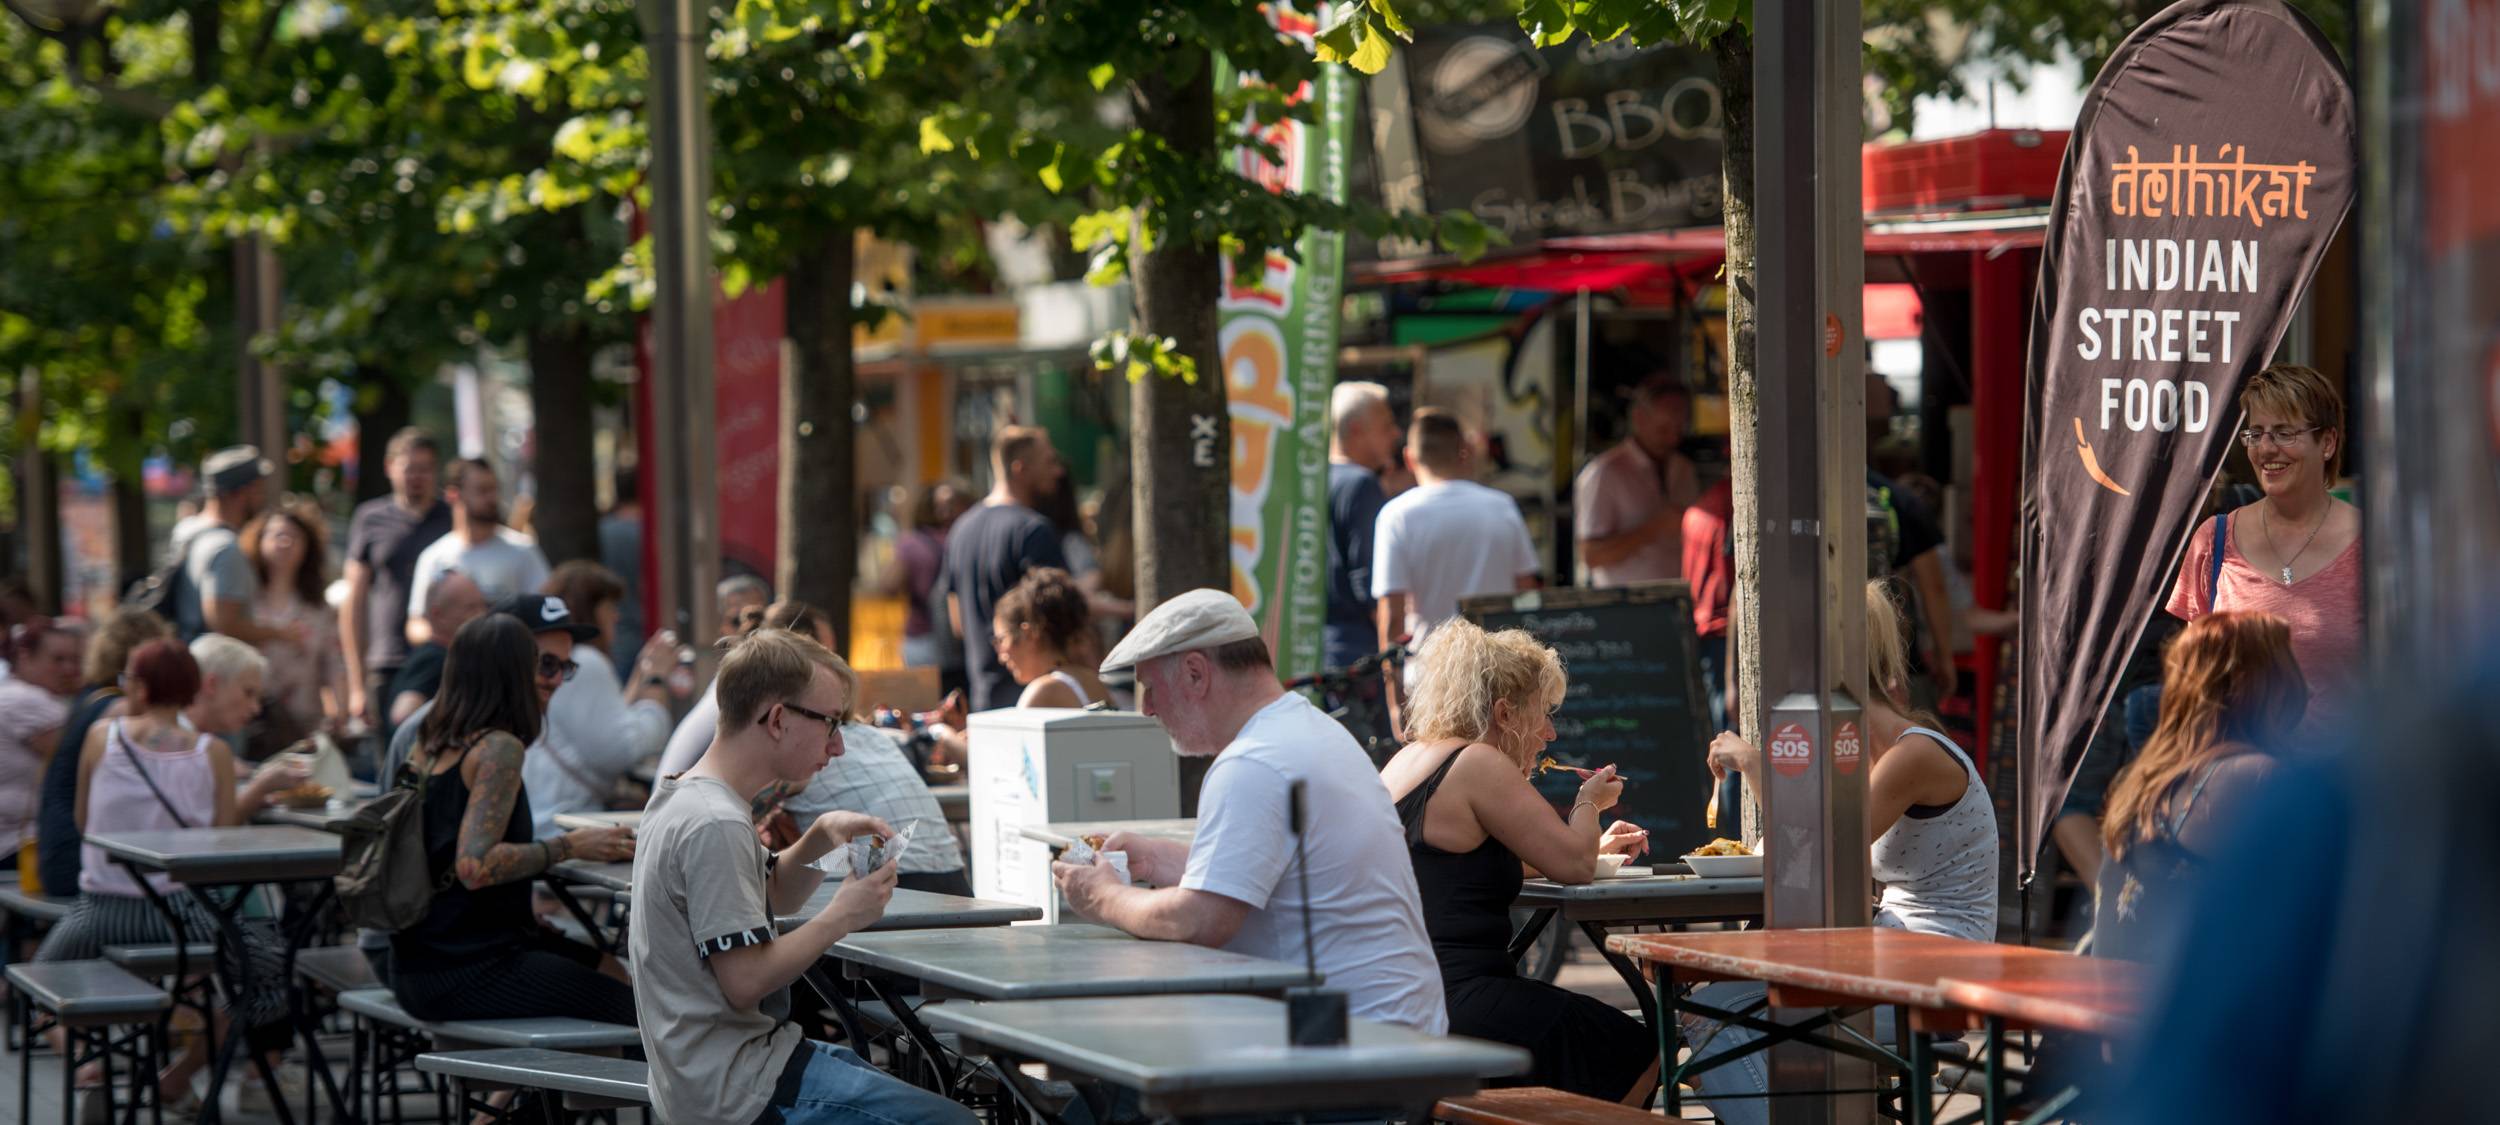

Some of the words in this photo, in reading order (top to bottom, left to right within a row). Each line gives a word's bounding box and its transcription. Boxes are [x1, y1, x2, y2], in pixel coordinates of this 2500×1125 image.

[2112, 143, 2317, 228] delhikat
[2106, 239, 2259, 293] INDIAN
[2077, 307, 2240, 364] STREET
[1297, 274, 1336, 475] CATERING
[2101, 378, 2210, 434] FOOD
[1771, 740, 1810, 757] SOS
[1834, 739, 1860, 756] SOS
